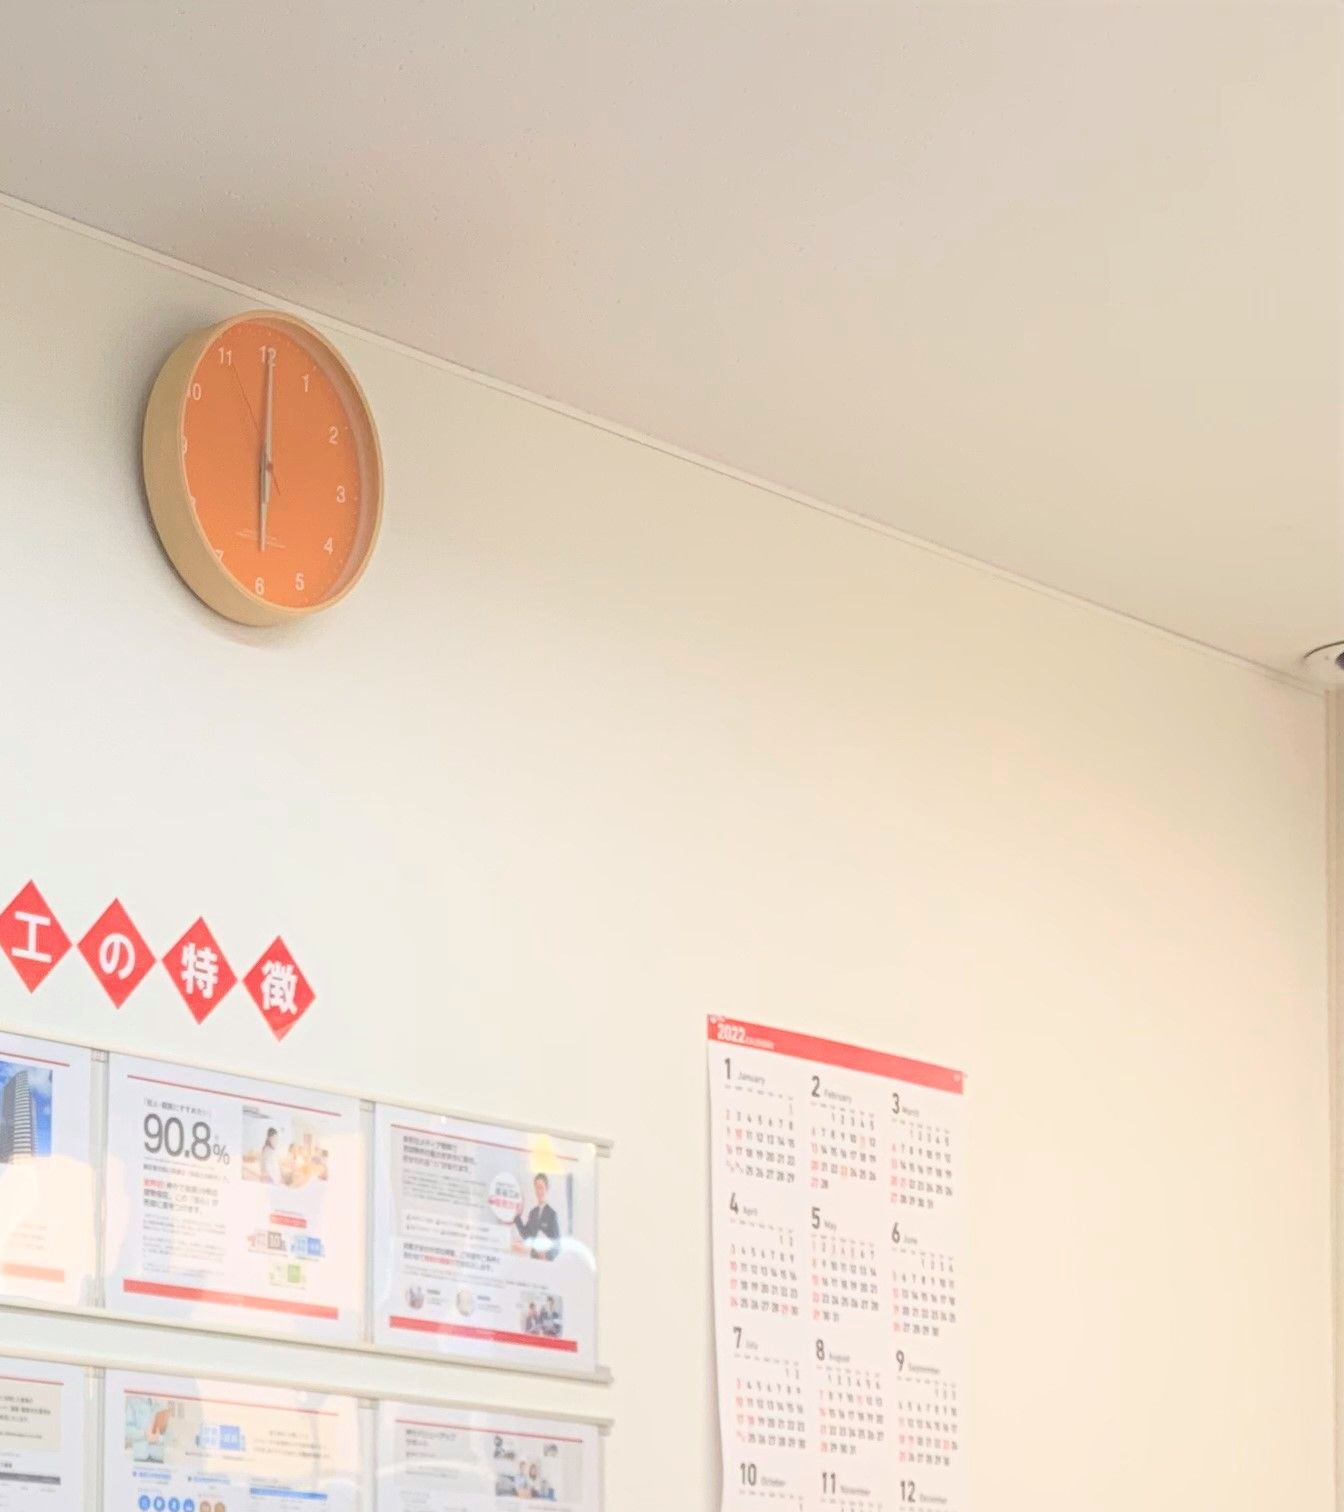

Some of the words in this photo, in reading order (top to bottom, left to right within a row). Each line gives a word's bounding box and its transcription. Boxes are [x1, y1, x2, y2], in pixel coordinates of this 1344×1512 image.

[218, 347, 233, 366] 11
[259, 346, 278, 368] 12
[302, 374, 311, 393] 1
[328, 426, 339, 445] 2
[336, 485, 346, 504] 3
[324, 537, 334, 555] 4
[255, 577, 265, 595] 6
[295, 572, 305, 592] 5
[717, 1023, 745, 1043] 2022
[724, 1057, 731, 1080] 1
[811, 1075, 820, 1098] 2
[892, 1092, 900, 1114] 3
[730, 1192, 739, 1215] 4
[811, 1206, 820, 1229] 5
[891, 1221, 901, 1244] 6
[733, 1326, 742, 1349] 7
[816, 1339, 825, 1361] 8
[896, 1350, 905, 1372] 9
[740, 1463, 757, 1486] 10
[822, 1472, 836, 1494] 11
[900, 1480, 916, 1503] 12
